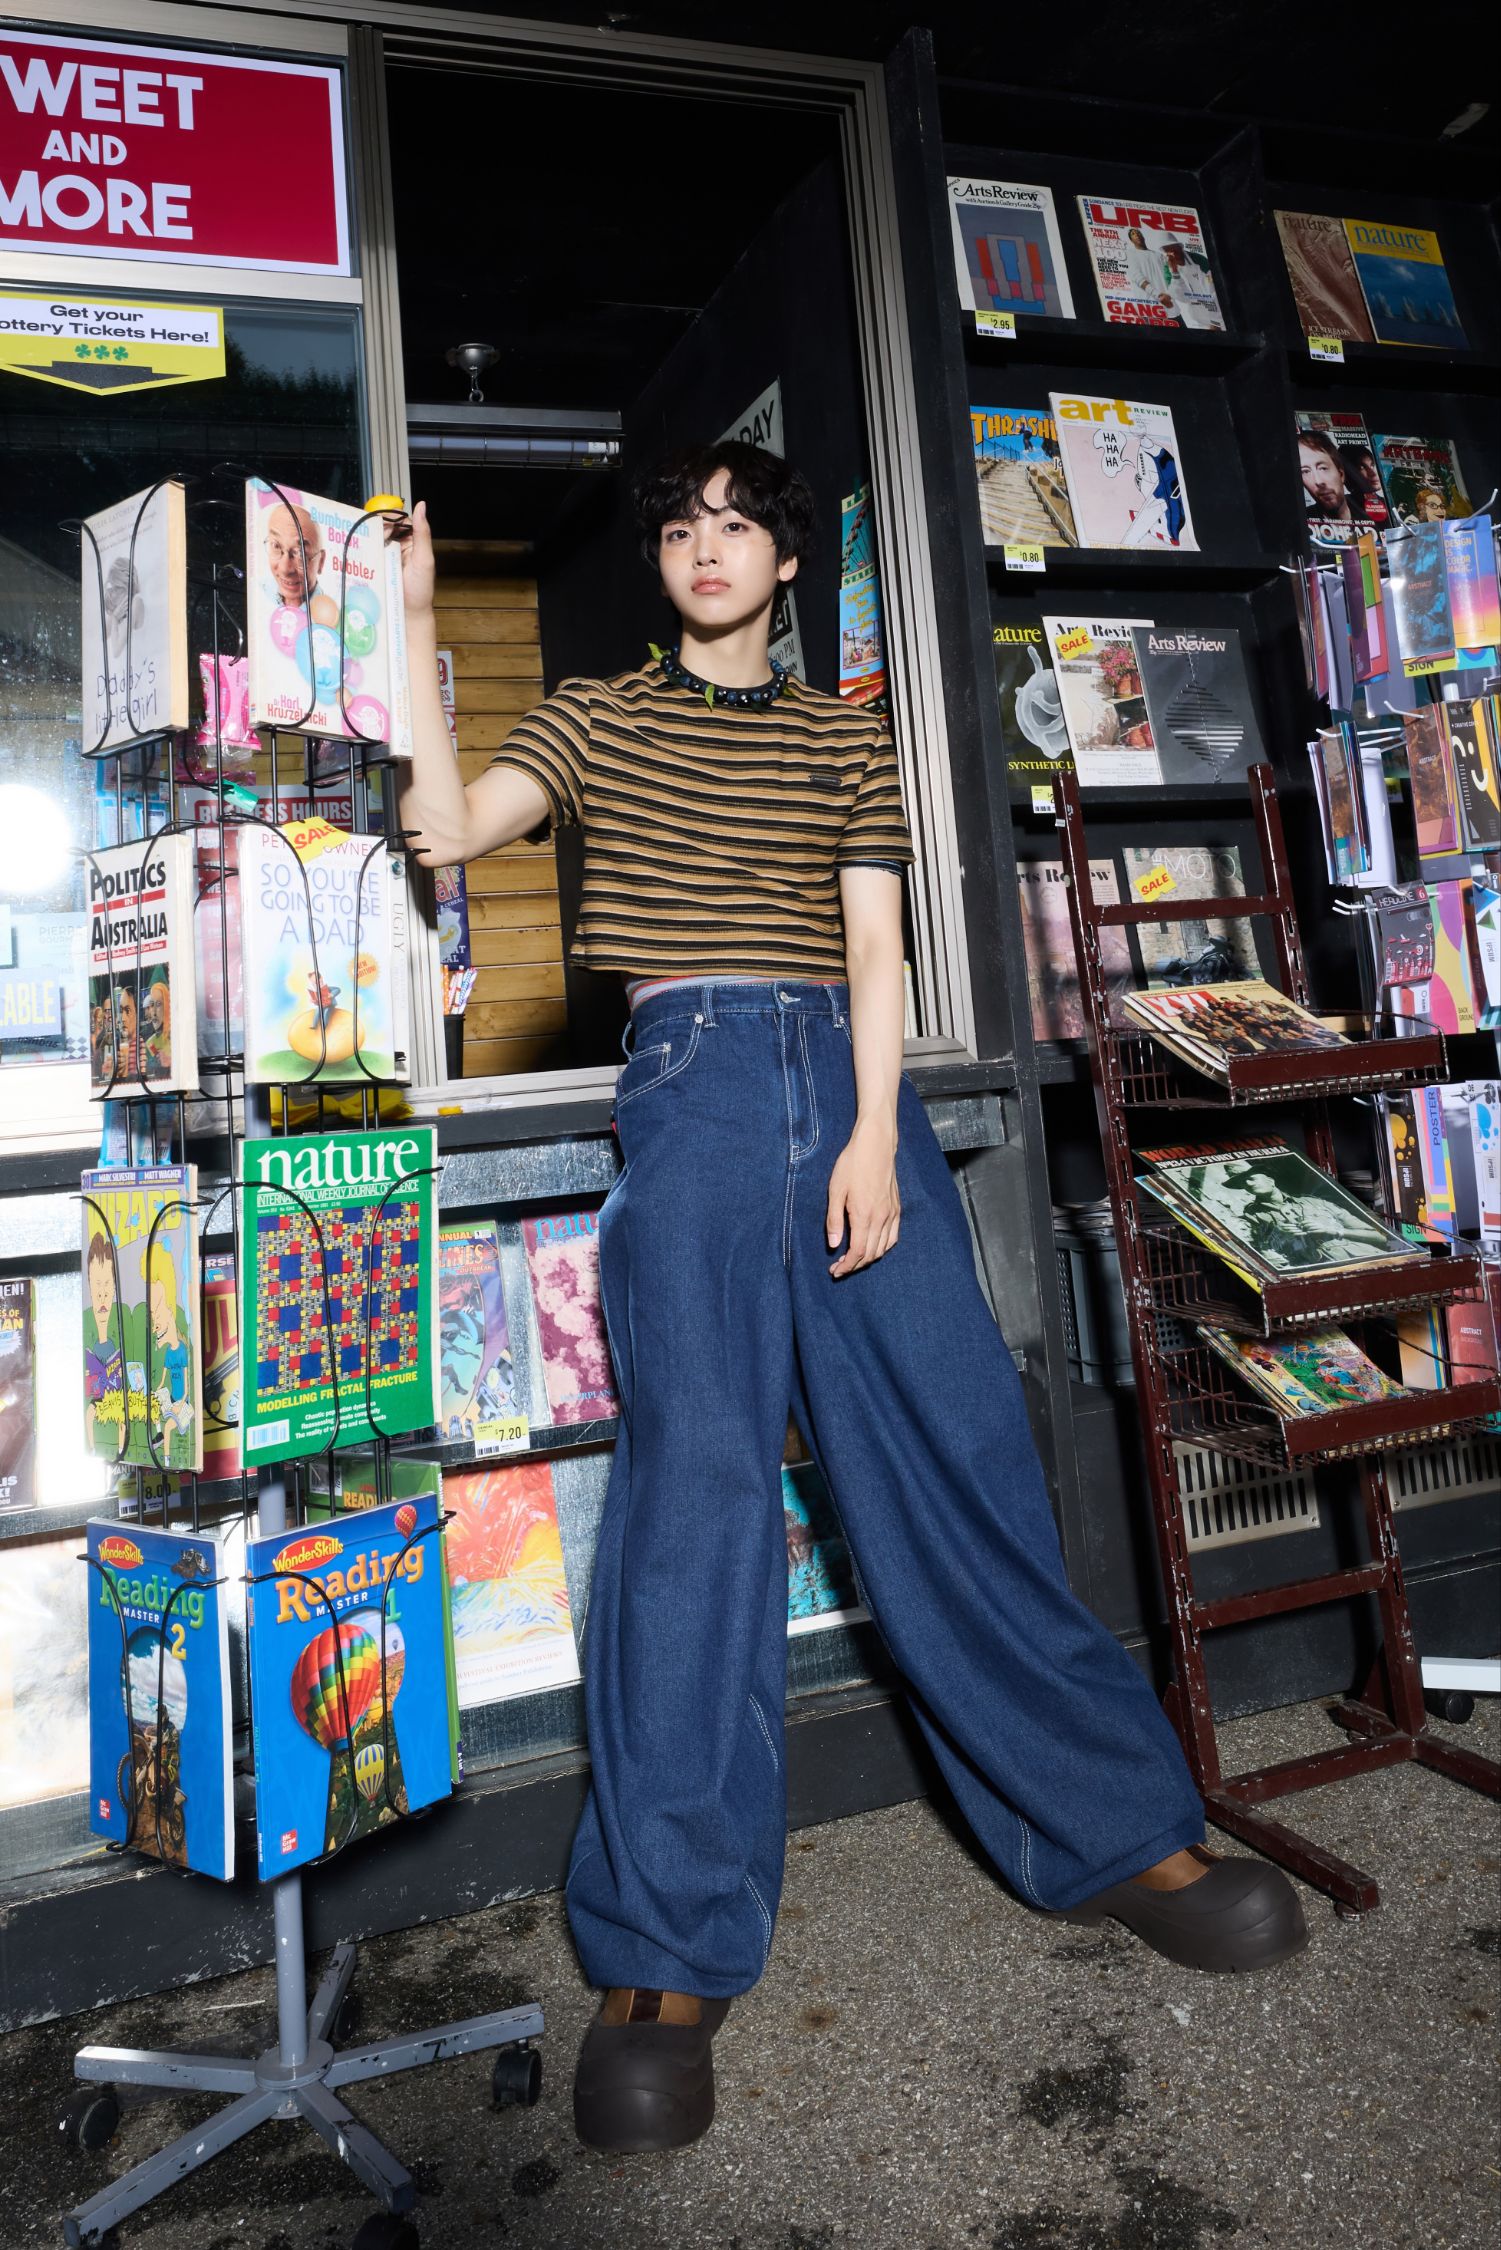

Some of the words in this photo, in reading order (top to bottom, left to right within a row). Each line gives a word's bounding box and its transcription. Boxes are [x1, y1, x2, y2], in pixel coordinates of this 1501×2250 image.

[0, 55, 203, 130] WEET
[42, 130, 127, 166] AND
[0, 170, 193, 240] MORE
[1090, 204, 1199, 235] URB
[1282, 213, 1331, 231] nature
[1354, 224, 1426, 252] nature
[50, 304, 88, 319] Get
[94, 308, 144, 323] your
[1107, 300, 1168, 319] GANG
[70, 322, 145, 340] Tickets
[151, 328, 209, 343] Here!
[738, 400, 774, 446] DAY
[1058, 399, 1134, 426] art
[1133, 407, 1168, 417] REVIEW
[1103, 433, 1117, 443] HA
[1106, 444, 1119, 454] HA
[1106, 456, 1118, 467] HA
[1445, 538, 1472, 546] DESIGN
[993, 627, 1042, 643] ature
[1060, 634, 1089, 653] SALE
[1175, 635, 1226, 651] Review
[783, 638, 795, 658] PM
[97, 657, 156, 698] Daddy's
[95, 704, 127, 734] little
[131, 688, 157, 728] girl
[267, 703, 327, 726] Kruszelicki
[1008, 761, 1065, 770] SYNTHETIC
[292, 801, 352, 821] HOURS
[293, 825, 336, 849] SALE
[1163, 853, 1236, 880] MOTO
[90, 860, 166, 901] POLITICS
[260, 863, 291, 887] SO
[298, 866, 379, 894] YOU'RE
[1141, 873, 1169, 895] SALE
[124, 897, 133, 905] IN
[260, 890, 324, 913] GOING
[328, 894, 354, 915] TO
[358, 896, 381, 916] BE
[444, 897, 464, 908] CEREAL
[1418, 890, 1425, 899] 6
[91, 911, 168, 950] AUSTRALIA
[280, 915, 300, 943] A
[308, 917, 365, 946] DAD
[393, 902, 405, 952] UGLY
[0, 981, 56, 1027] ABLE
[1427, 1091, 1441, 1146] POSTER
[1139, 1144, 1216, 1162] WORLD
[1187, 1153, 1236, 1166] VICTORY
[1234, 1150, 1250, 1159] IN
[1249, 1146, 1290, 1158] BURMA
[98, 1172, 112, 1182] MARC
[112, 1171, 135, 1181] SILVESTRI
[144, 1170, 158, 1180] MATT
[158, 1169, 181, 1179] WAGNER
[257, 1139, 419, 1192] nature
[316, 1187, 347, 1200] WEEKLY
[347, 1184, 379, 1197] JOURNAL
[86, 1189, 182, 1250] WIZARD
[1406, 1224, 1427, 1235] SIGN
[459, 1265, 492, 1273] OUTBREAK
[9, 1309, 20, 1317] OF
[257, 1392, 317, 1414] MODELLING
[370, 1371, 418, 1391] FRACTURE
[305, 1411, 325, 1421] Chaotic
[295, 1432, 305, 1440] The
[306, 1428, 323, 1437] reality
[348, 1420, 358, 1428] and
[495, 1426, 522, 1442] $7.20
[99, 1539, 144, 1565] WonderSkills
[272, 1536, 344, 1573] WonderSkills
[275, 1544, 425, 1624] Reading
[99, 1566, 206, 1629] Reading
[316, 1591, 369, 1617] MASTER
[384, 1588, 402, 1624] 1
[122, 1607, 160, 1624] MASTER
[171, 1622, 187, 1660] 2
[282, 1833, 291, 1841] Mc
